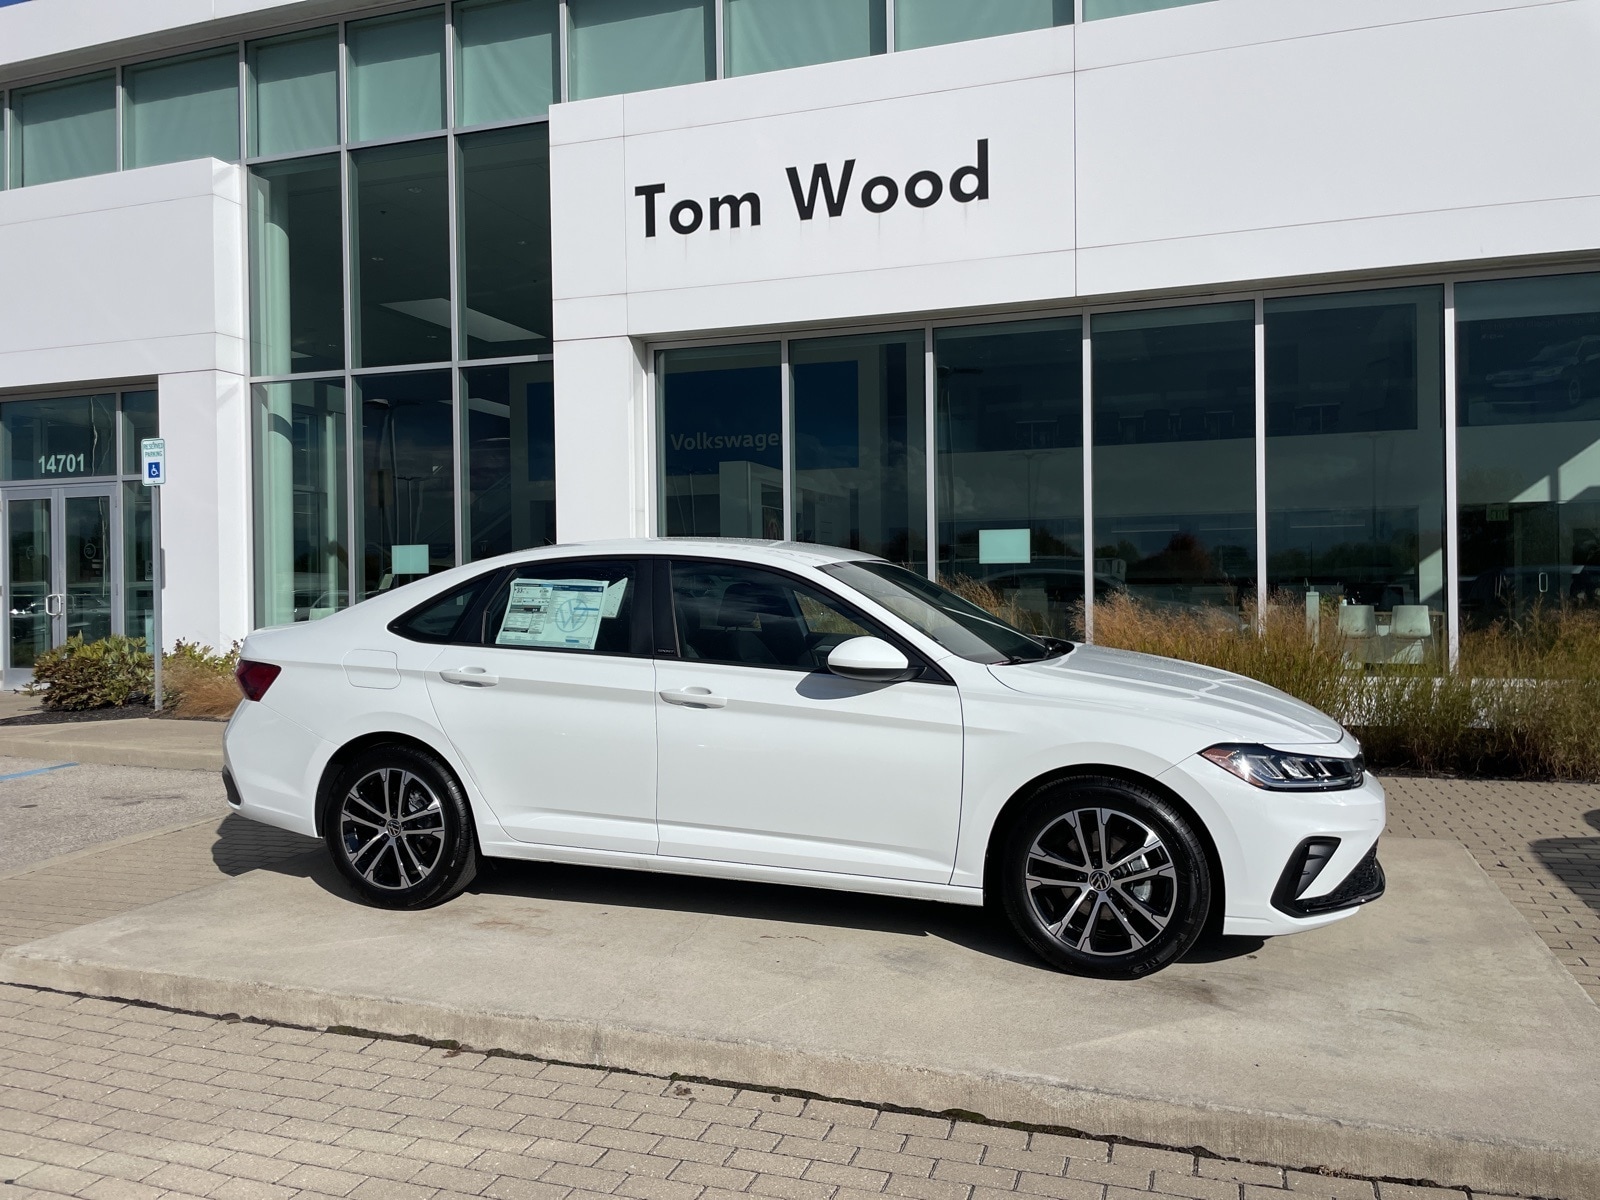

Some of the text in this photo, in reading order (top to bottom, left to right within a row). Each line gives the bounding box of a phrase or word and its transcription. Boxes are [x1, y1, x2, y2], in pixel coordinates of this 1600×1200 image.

[634, 138, 989, 238] Tom Wood
[143, 442, 164, 450] RESERVED
[670, 431, 782, 452] Volkswage
[38, 453, 84, 474] 14701
